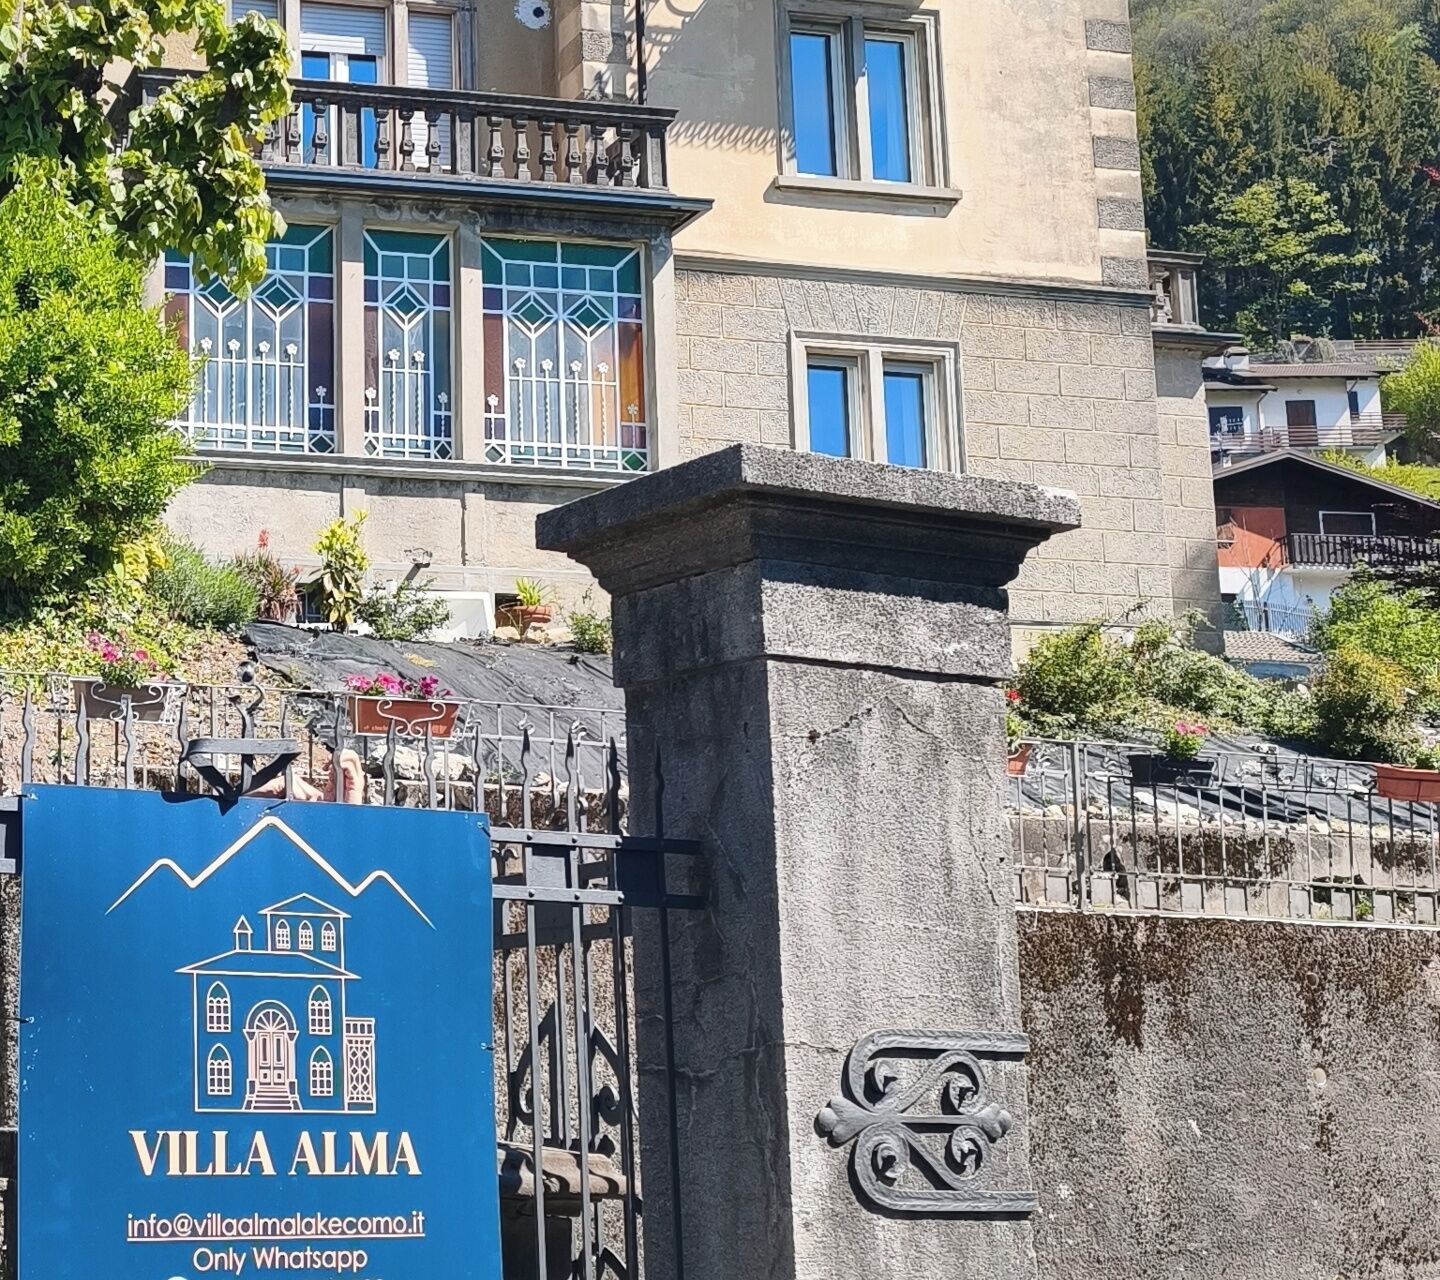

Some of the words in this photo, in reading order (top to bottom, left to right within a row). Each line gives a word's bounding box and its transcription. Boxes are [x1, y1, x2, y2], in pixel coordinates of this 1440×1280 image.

[129, 1130, 277, 1176] VILLA
[288, 1130, 422, 1176] ALMA
[127, 1210, 425, 1239] info@villaalmalakecomo.it
[193, 1248, 247, 1276] Only
[253, 1247, 368, 1273] Whatsapp
